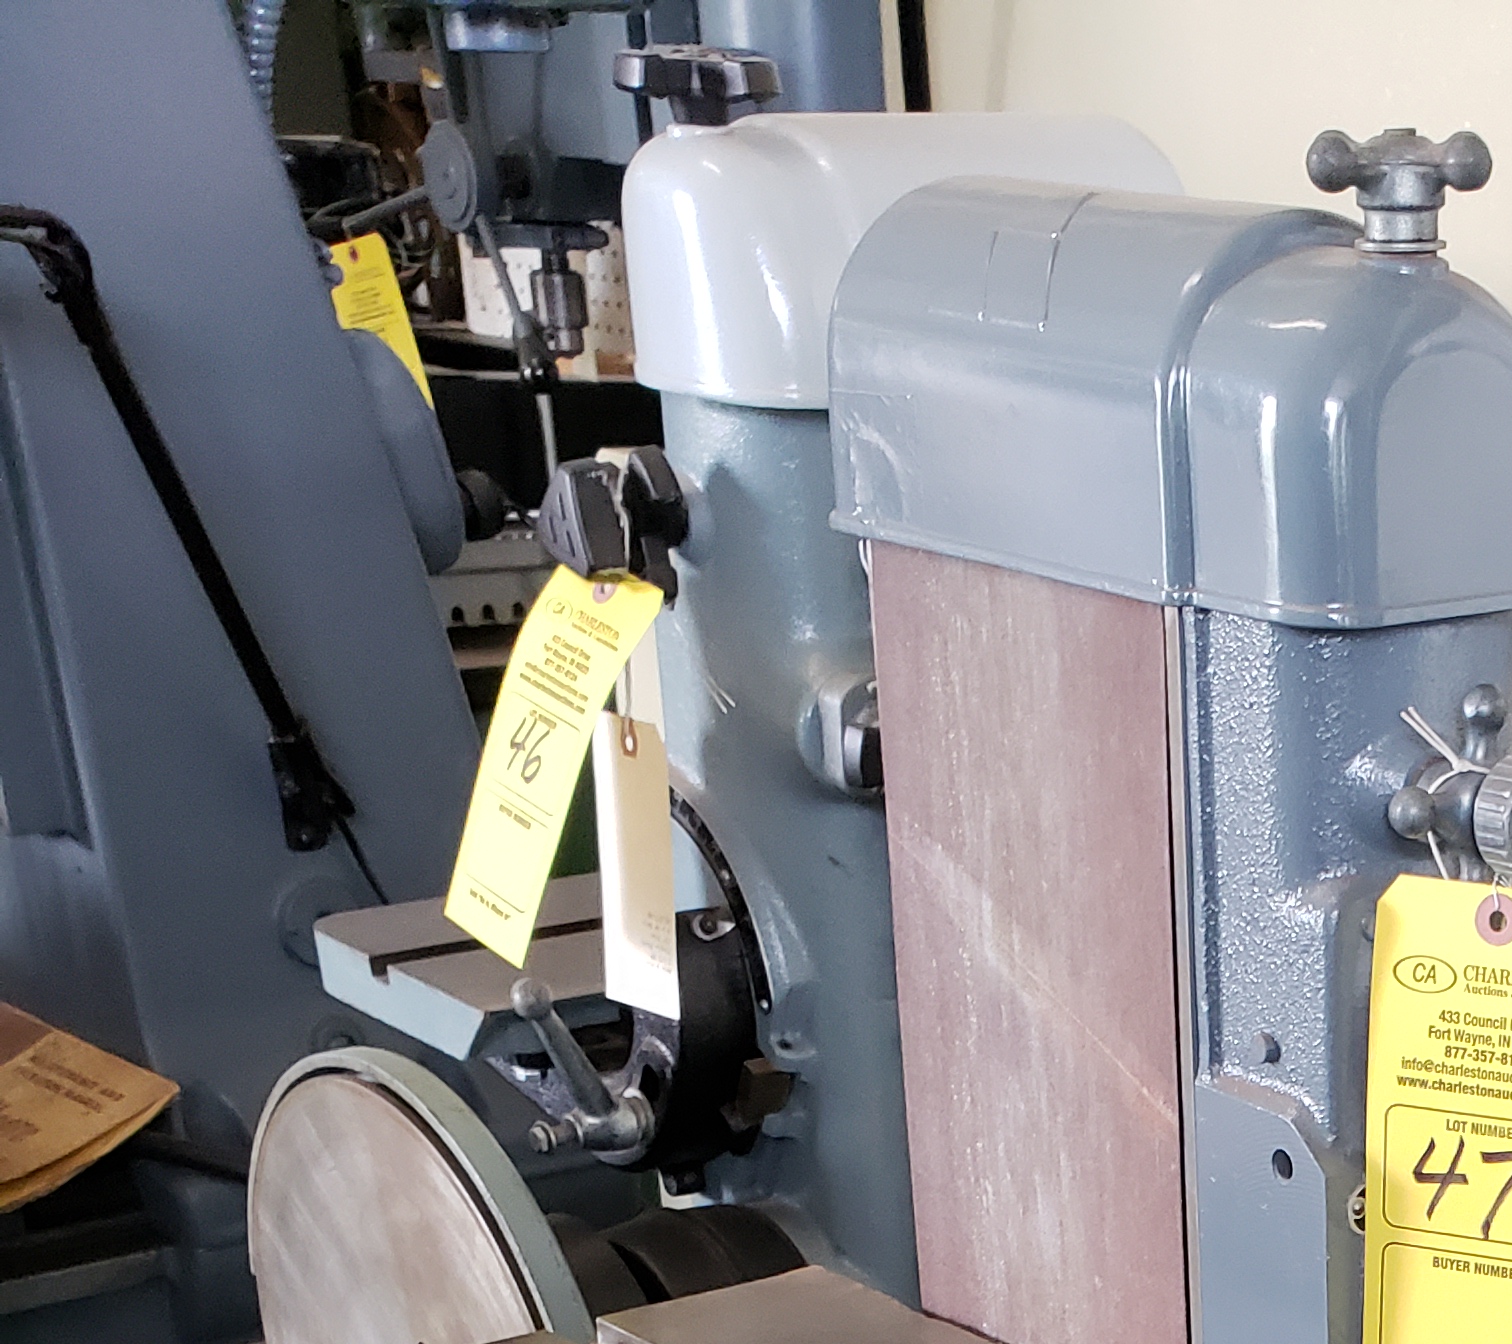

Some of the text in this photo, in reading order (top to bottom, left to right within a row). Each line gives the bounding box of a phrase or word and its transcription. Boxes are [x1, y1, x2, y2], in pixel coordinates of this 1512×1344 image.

[506, 716, 551, 784] 46
[1412, 962, 1438, 985] CA
[1463, 983, 1509, 998] Auctions
[1438, 1009, 1461, 1025] 433
[1463, 1012, 1508, 1031] Council
[1427, 1024, 1452, 1042] Fort
[1454, 1028, 1496, 1049] Wayne,
[1498, 1034, 1511, 1048] IN
[1445, 1118, 1468, 1135] LOT
[1432, 1256, 1471, 1275] BUYER
